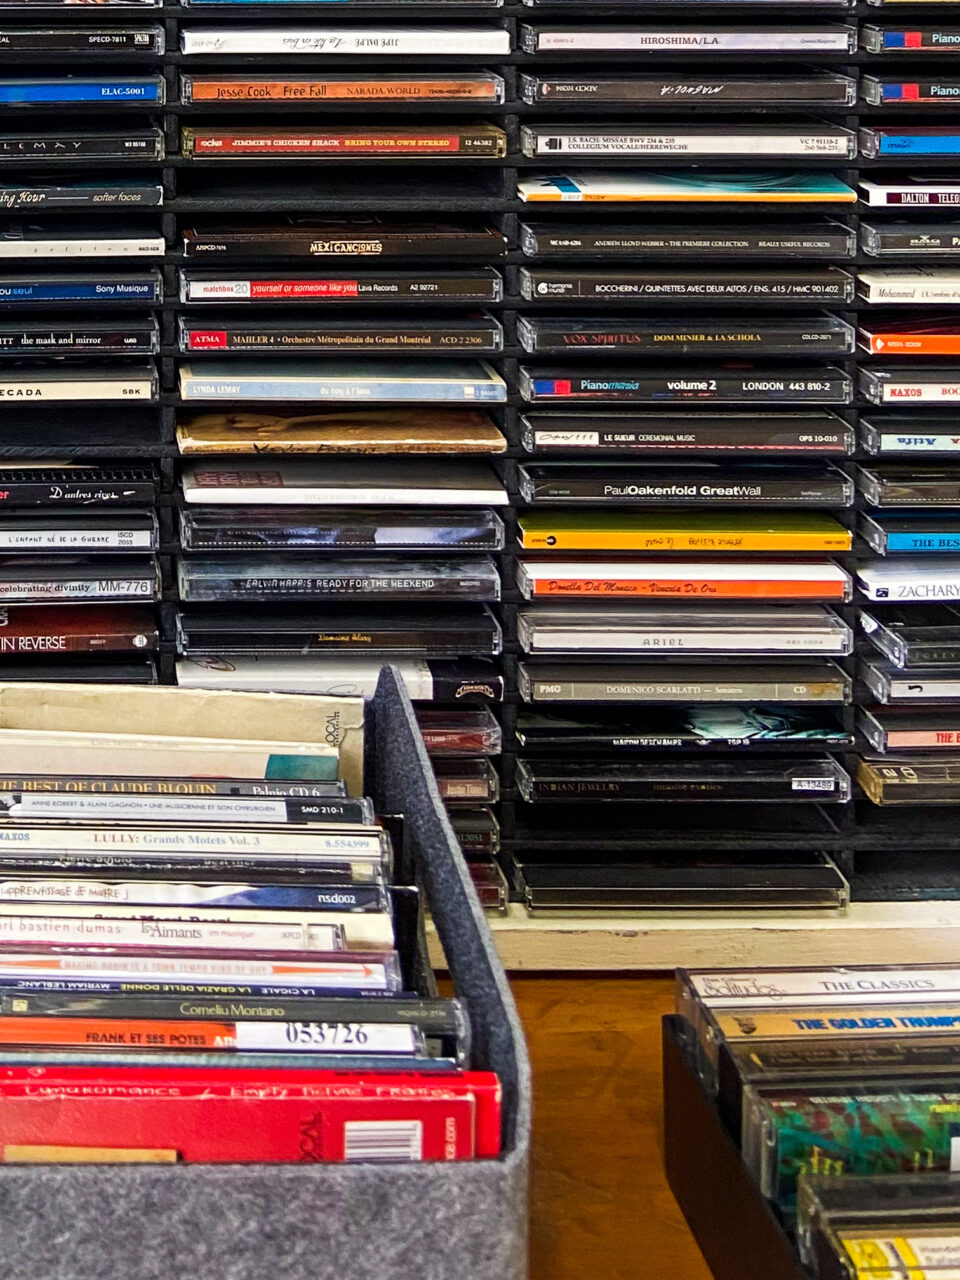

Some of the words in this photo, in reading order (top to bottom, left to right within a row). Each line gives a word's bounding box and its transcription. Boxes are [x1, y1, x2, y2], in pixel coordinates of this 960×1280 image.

[902, 193, 929, 203] DALTON
[96, 285, 115, 293] Sony
[117, 284, 148, 293] Musique
[252, 284, 282, 293] yourself
[294, 284, 325, 292] someone
[328, 283, 341, 291] like
[343, 284, 357, 293] you
[667, 380, 706, 390] volume
[708, 380, 716, 390] 2
[743, 382, 784, 391] LONDON
[789, 382, 805, 390] 443
[807, 382, 830, 390] 810-2
[890, 388, 922, 397] NAXOS
[98, 580, 148, 593] MM-776
[0, 638, 15, 650] IN
[18, 636, 66, 649] REVERSE
[94, 833, 140, 844] LULLY:
[144, 835, 186, 846] Grands
[190, 835, 226, 846] Motets
[229, 836, 251, 846] Vol.
[254, 837, 260, 846] 3
[318, 894, 356, 905] nsd002
[819, 981, 855, 992] THE
[858, 979, 935, 990] CLASSICS
[792, 1019, 828, 1029] THE
